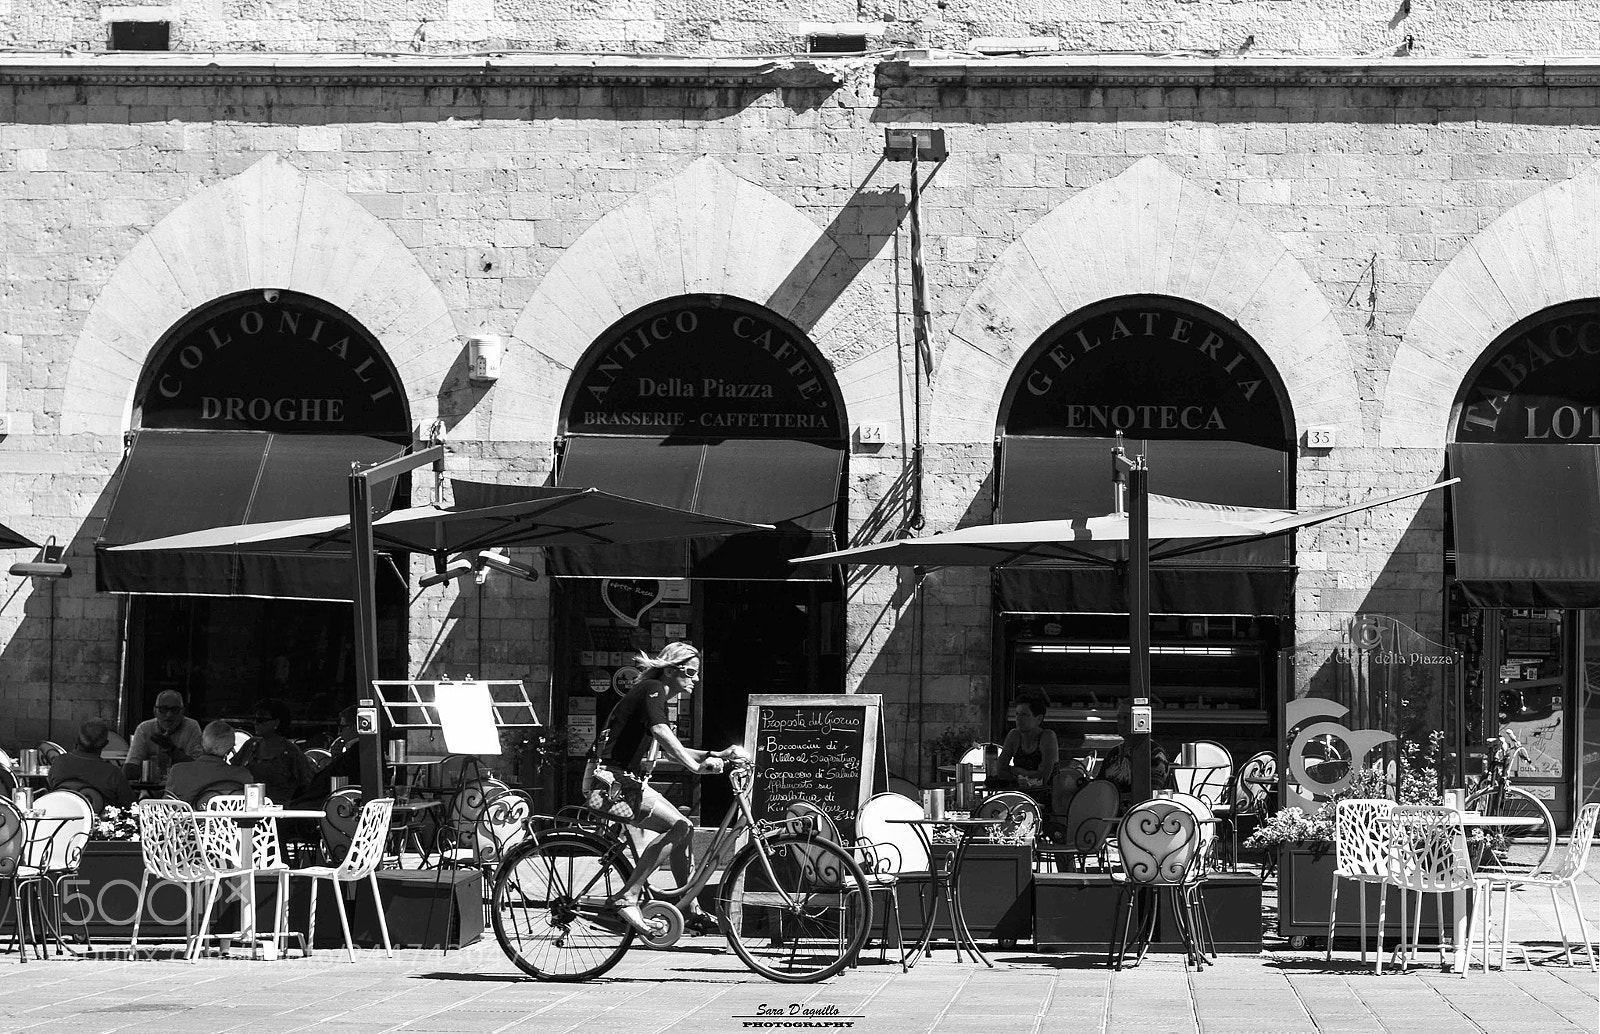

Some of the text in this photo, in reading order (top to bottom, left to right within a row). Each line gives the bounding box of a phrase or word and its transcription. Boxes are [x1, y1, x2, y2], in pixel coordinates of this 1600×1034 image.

[159, 310, 395, 402] COLONIALI
[587, 310, 698, 402] ANTICO
[1026, 312, 1264, 401] GELATERIA
[638, 378, 773, 398] Della Piazza
[200, 396, 345, 422] DROGHE
[1066, 404, 1227, 430] ENOTECA
[584, 411, 685, 426] BRASSERIE
[700, 412, 830, 428] CAFFETTERIA
[863, 427, 880, 440] 34
[1311, 431, 1329, 443] 35
[1375, 650, 1406, 664] della
[1409, 651, 1453, 666] Piazza
[762, 709, 860, 734] Proposta del Giorno
[826, 740, 838, 750] di
[815, 768, 825, 778] di
[824, 791, 835, 801] di
